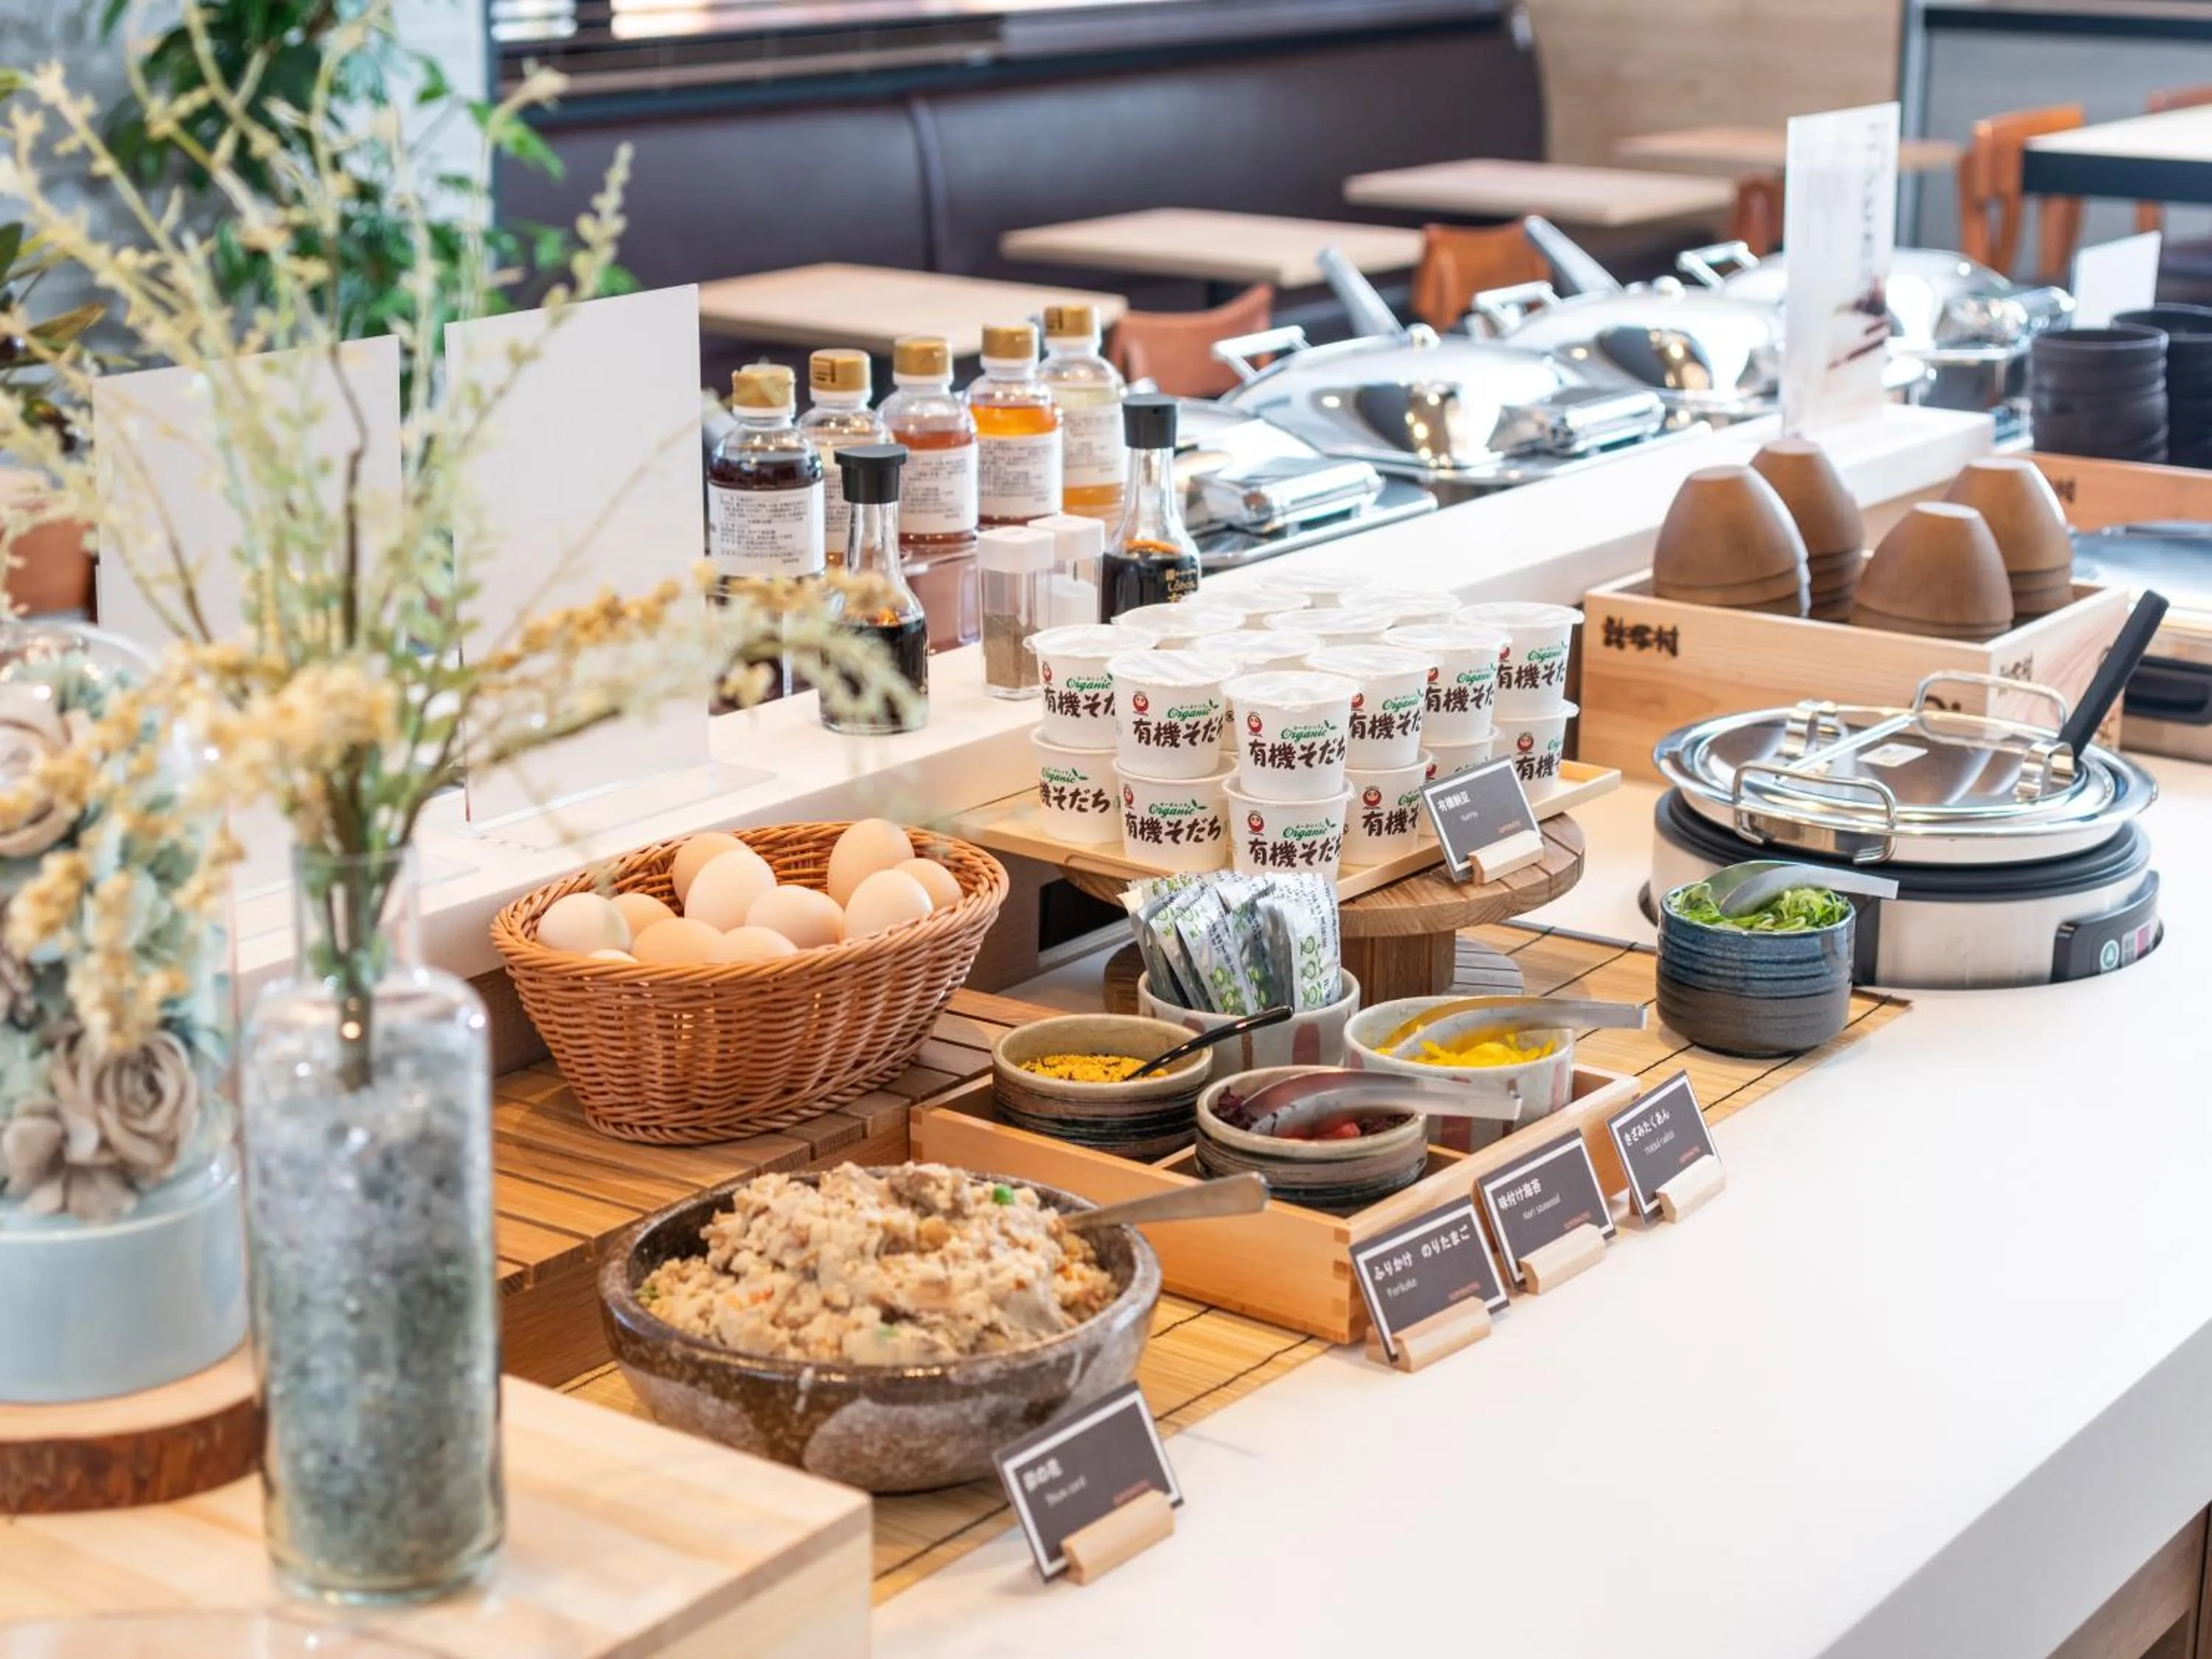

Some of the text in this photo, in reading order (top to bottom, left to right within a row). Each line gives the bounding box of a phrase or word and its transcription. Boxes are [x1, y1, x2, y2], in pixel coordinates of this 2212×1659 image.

[1149, 803, 1195, 817] Organic
[1125, 812, 1222, 844] 有機そだち
[1374, 1224, 1471, 1281] ふりかけ のりたまご
